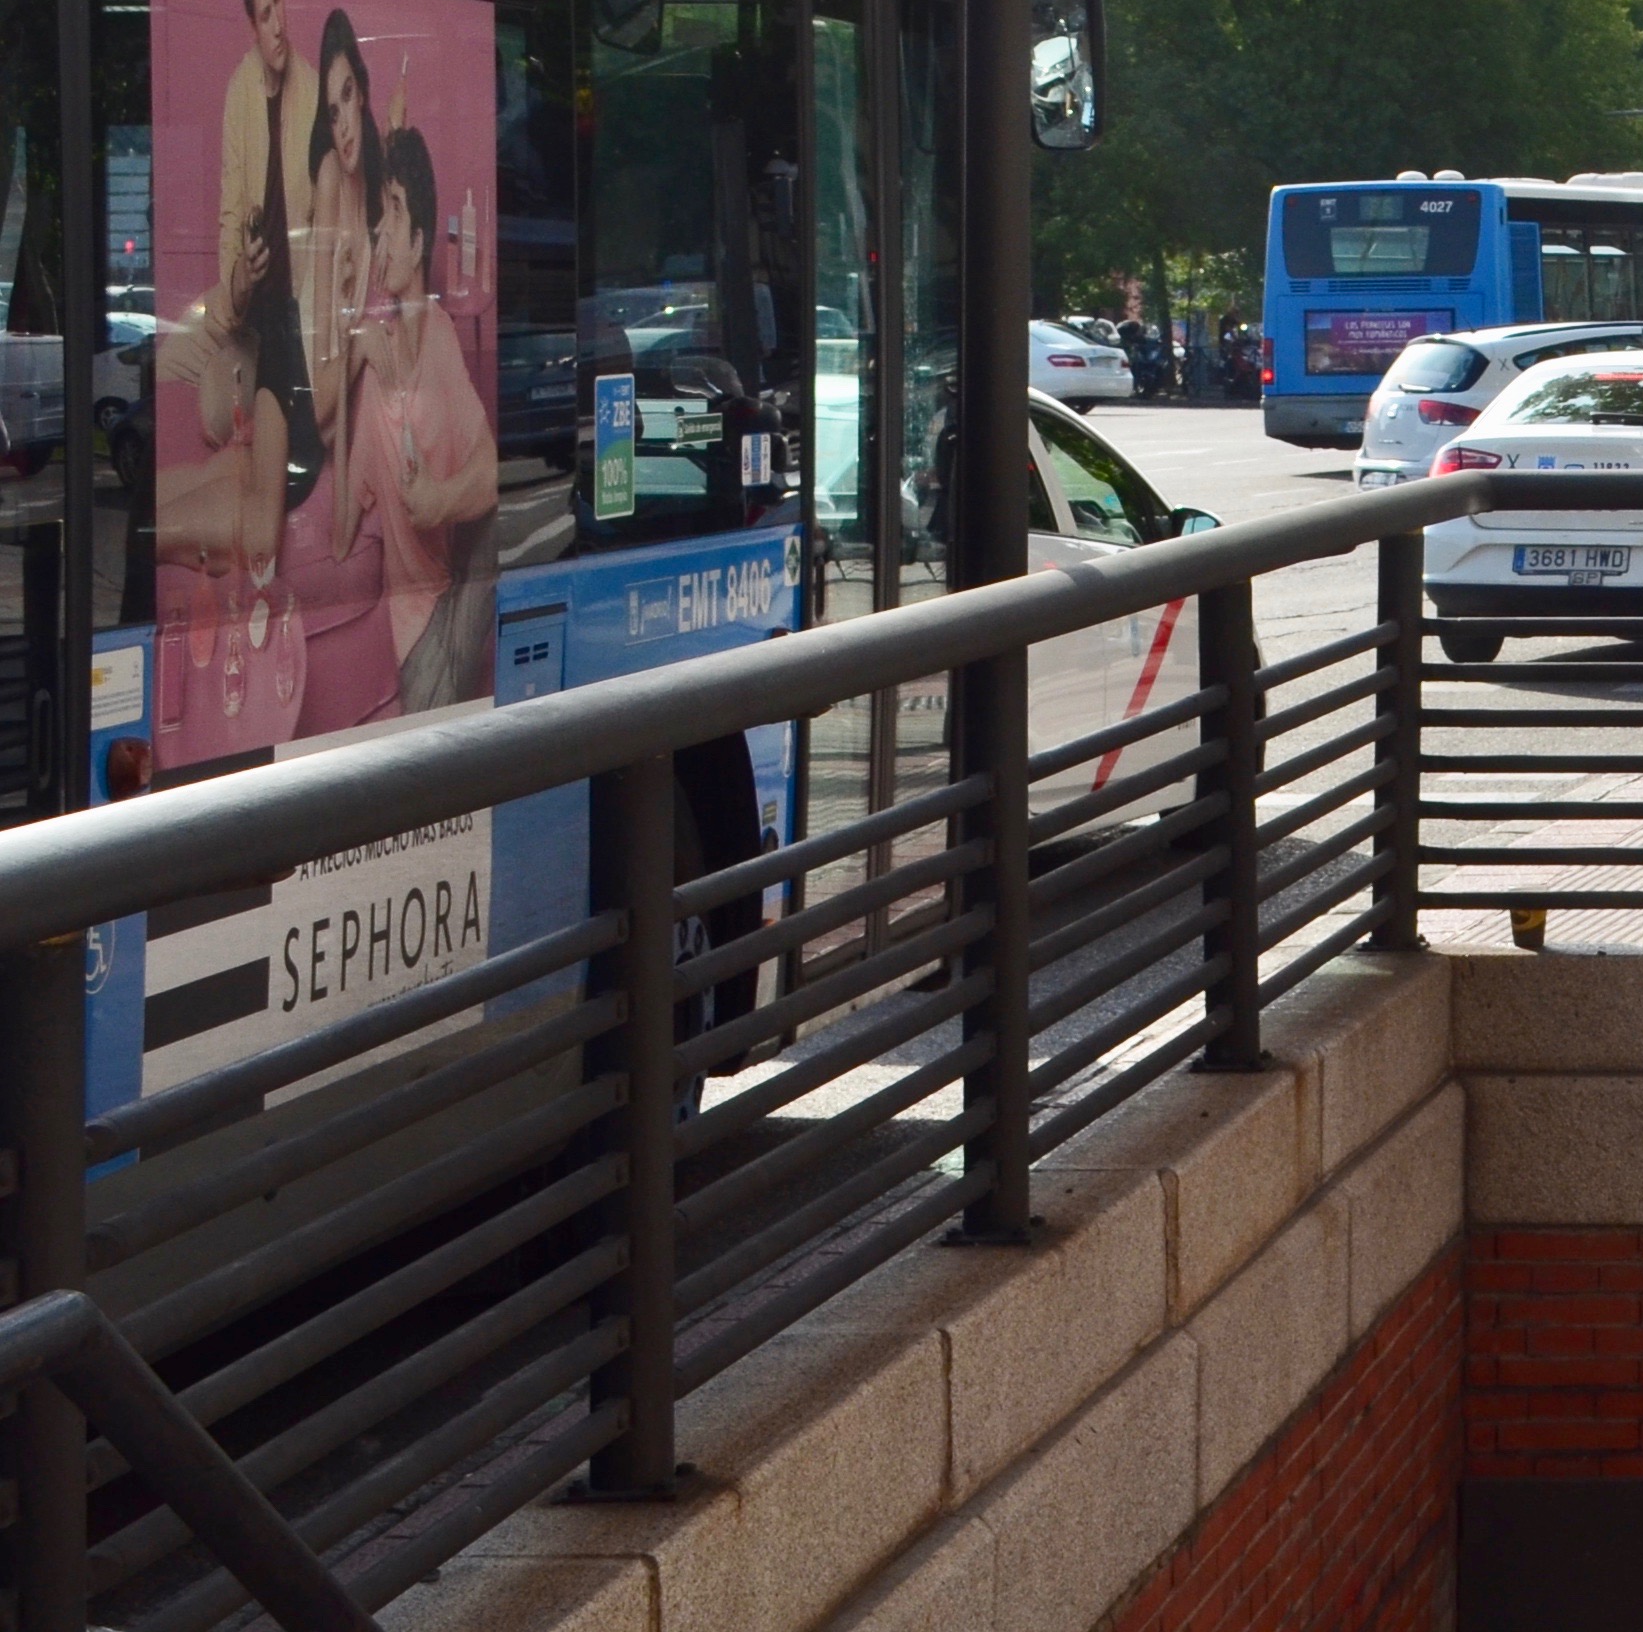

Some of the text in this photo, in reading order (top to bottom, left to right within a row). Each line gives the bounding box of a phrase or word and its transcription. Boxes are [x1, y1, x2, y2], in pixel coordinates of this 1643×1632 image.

[1420, 201, 1453, 213] 4027
[613, 400, 631, 428] ZBE
[602, 457, 628, 488] 100%
[1529, 549, 1623, 567] 3681 HWD
[678, 568, 721, 633] EMT
[726, 558, 771, 623] 8406
[282, 870, 481, 1013] SEPHORA
